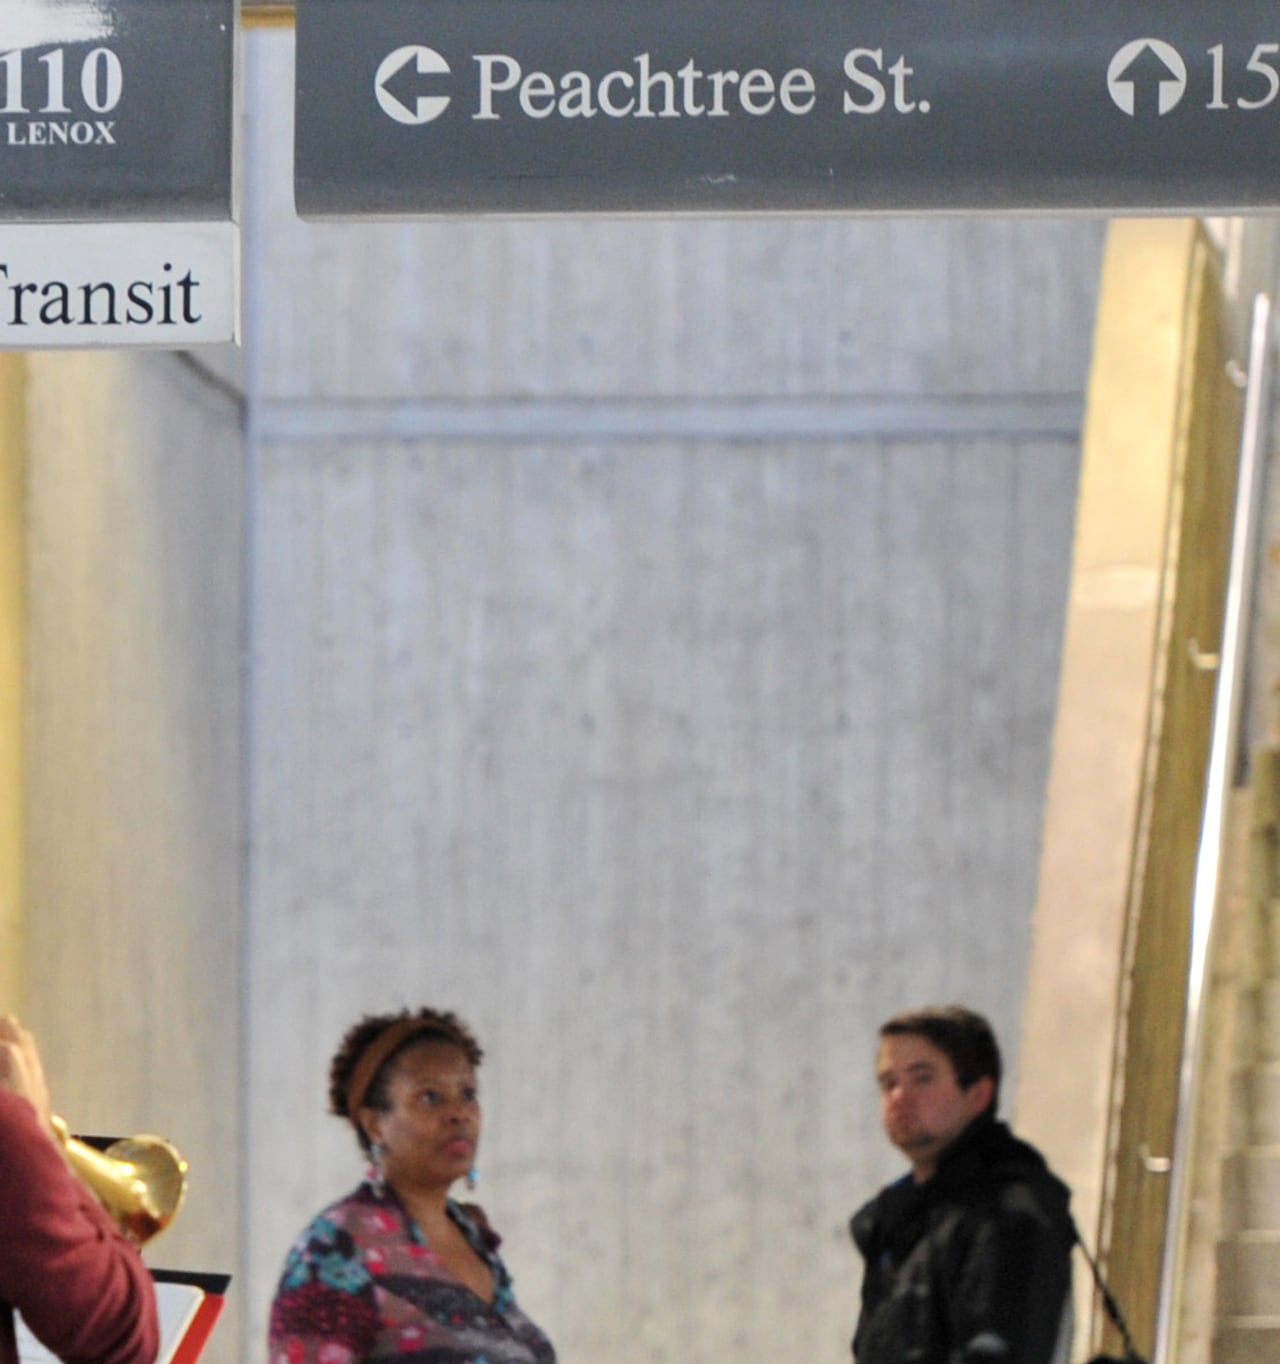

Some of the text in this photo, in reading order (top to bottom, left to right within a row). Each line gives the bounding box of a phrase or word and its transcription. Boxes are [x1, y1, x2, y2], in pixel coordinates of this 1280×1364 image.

[472, 48, 932, 121] Peachtree St.
[1205, 42, 1280, 110] 15
[7, 121, 117, 146] LENOX
